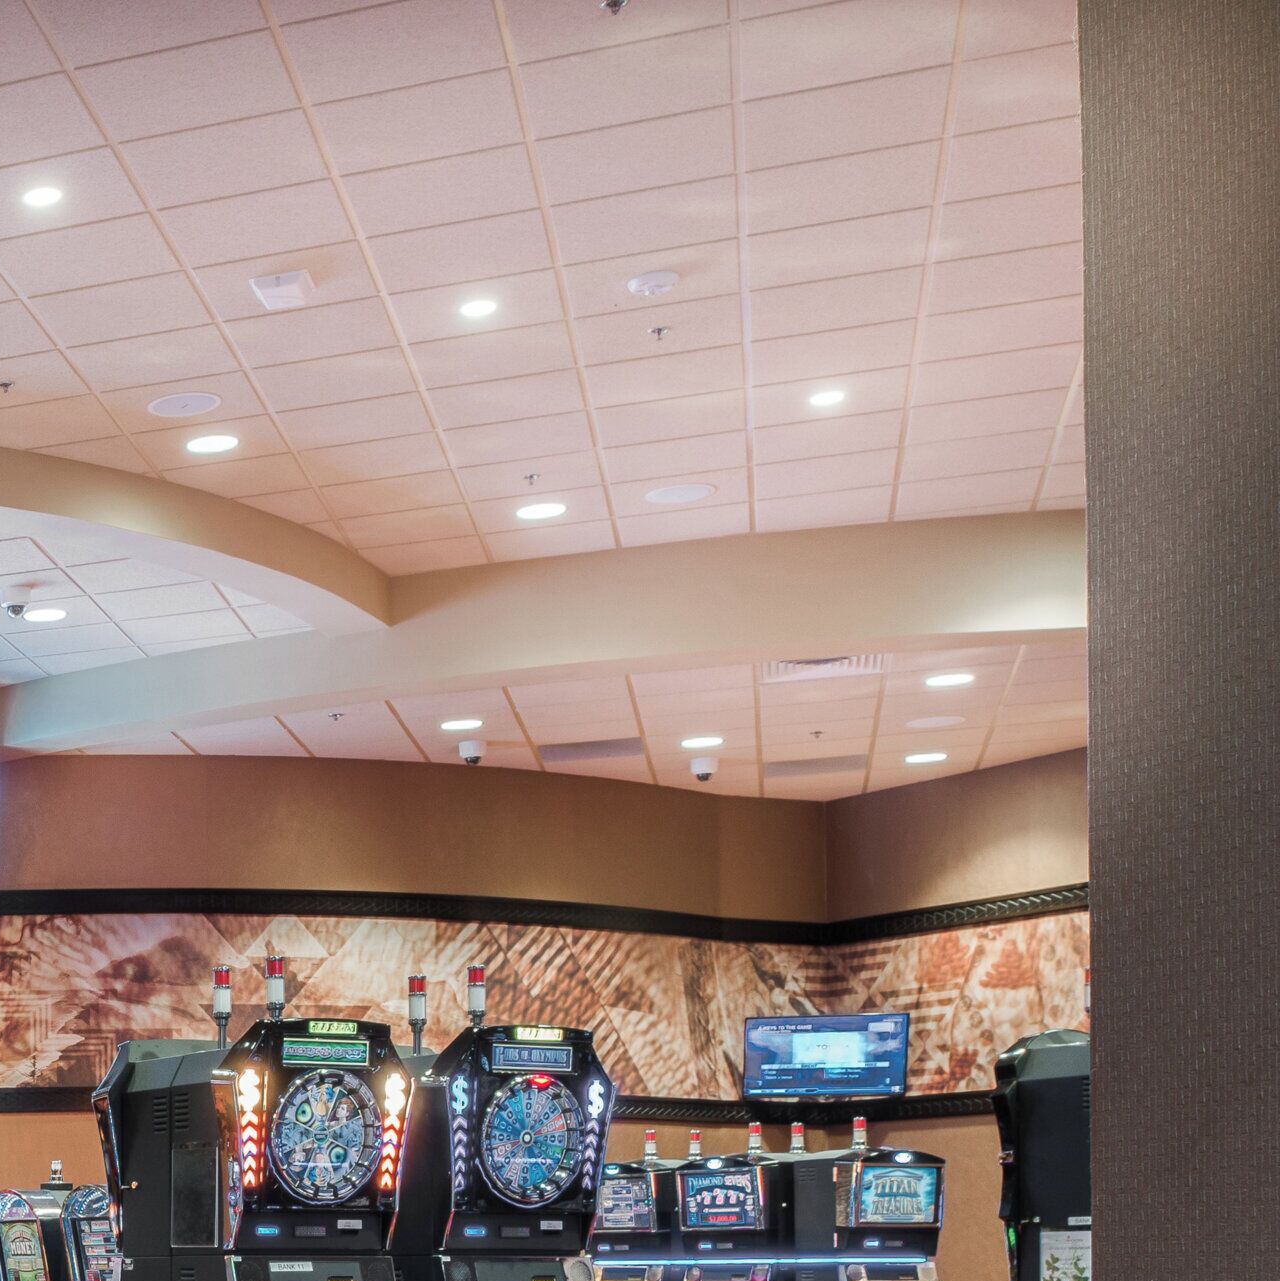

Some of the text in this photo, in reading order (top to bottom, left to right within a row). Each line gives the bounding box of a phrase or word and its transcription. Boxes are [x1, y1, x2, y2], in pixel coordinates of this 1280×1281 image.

[688, 1172, 751, 1194] DIAMOND SEVENS
[874, 1178, 919, 1194] TITAN
[10, 1241, 36, 1255] MONEY
[277, 1263, 297, 1271] BANK
